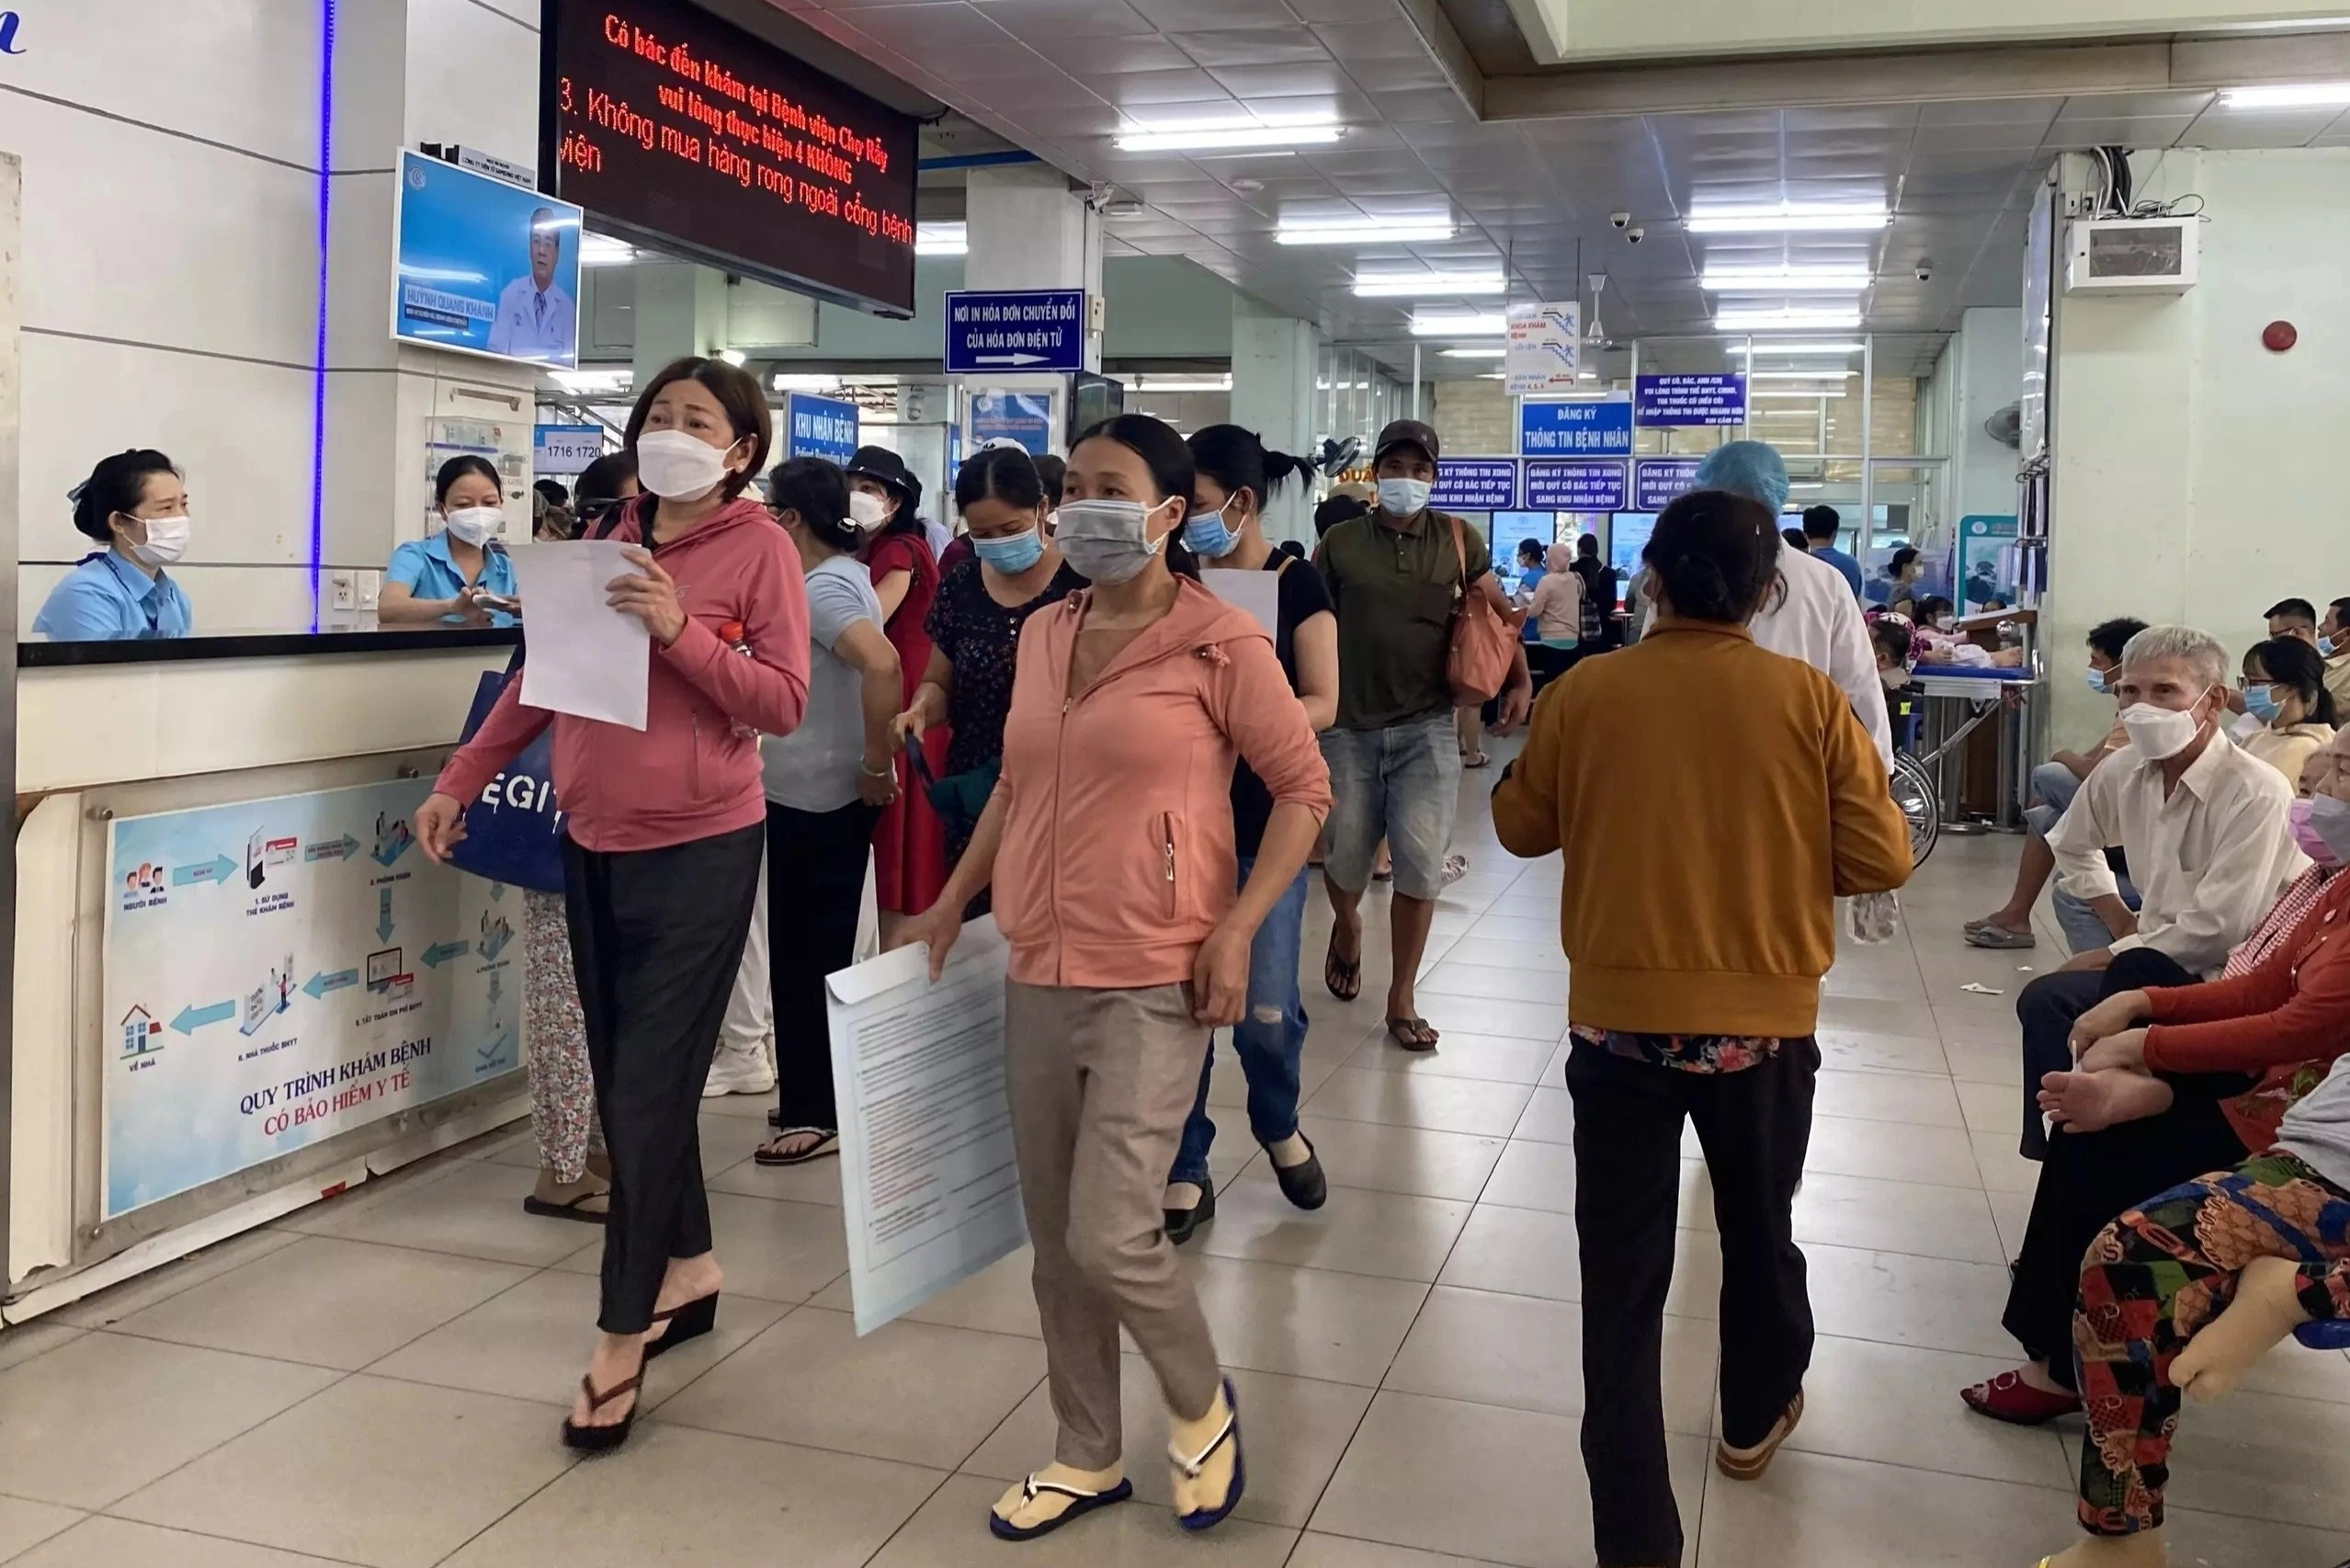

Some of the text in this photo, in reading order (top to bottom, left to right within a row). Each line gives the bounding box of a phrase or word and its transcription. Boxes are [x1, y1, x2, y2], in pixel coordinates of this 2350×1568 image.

[605, 14, 888, 174] Cô bác đến khám tại Bệnh viện Chợ Rẫy
[658, 85, 852, 185] vui lòng thực hiện 4 KHÔNG
[560, 130, 601, 173] viện
[560, 77, 913, 245] 3. Không mua hàng rong ngoài cổng bệnh
[437, 294, 464, 312] QUANG
[954, 296, 1075, 322] NƠI IN HÓA ĐƠN CHUYỂN ĐỔI
[967, 326, 1062, 350] CỦA HÓA ĐƠN ĐIỆN TỬ
[1557, 405, 1597, 420] ĐĂNG KÝ
[795, 410, 854, 448] KHU NHẬN BỆNH
[1525, 426, 1629, 452] THÔNG TIN BỆNH NHÂN
[548, 446, 601, 458] 1716 1720
[1444, 467, 1453, 476] KÝ
[1455, 467, 1478, 476] THÔNG
[1479, 468, 1492, 476] TIN
[1492, 468, 1512, 476] XONG
[1530, 467, 1622, 477] ĐĂNG KÝ THÔNG TIN XONG
[1641, 467, 1697, 477] ĐĂNG KÝ THÔN
[1438, 480, 1452, 489] QUÝ
[1453, 480, 1463, 489] CÔ
[1464, 480, 1480, 489] BÁC
[1480, 479, 1496, 489] TIẾP
[1497, 481, 1511, 491] TỤC
[1530, 479, 1621, 492] MỜI QUÝ CÔ BÁC TIẾP TỤC
[1641, 480, 1657, 490] MỜI
[1658, 480, 1673, 490] QUÝ
[1675, 480, 1685, 490] CÔ
[1429, 493, 1505, 505] SANG KHU NHẬN BỆNH
[1536, 494, 1616, 506] SANG KHU NHẬN BỆNH
[123, 896, 167, 911] NGƯỜI BỆNH
[259, 903, 277, 915] KHÁM
[278, 901, 294, 911] BỆNH
[260, 1041, 279, 1055] THUỐC
[240, 1037, 431, 1115] QUY TRÌNH KHÁM BỆNH
[264, 1062, 410, 1135] CÓ BẢO HIỂM Y TẾ
